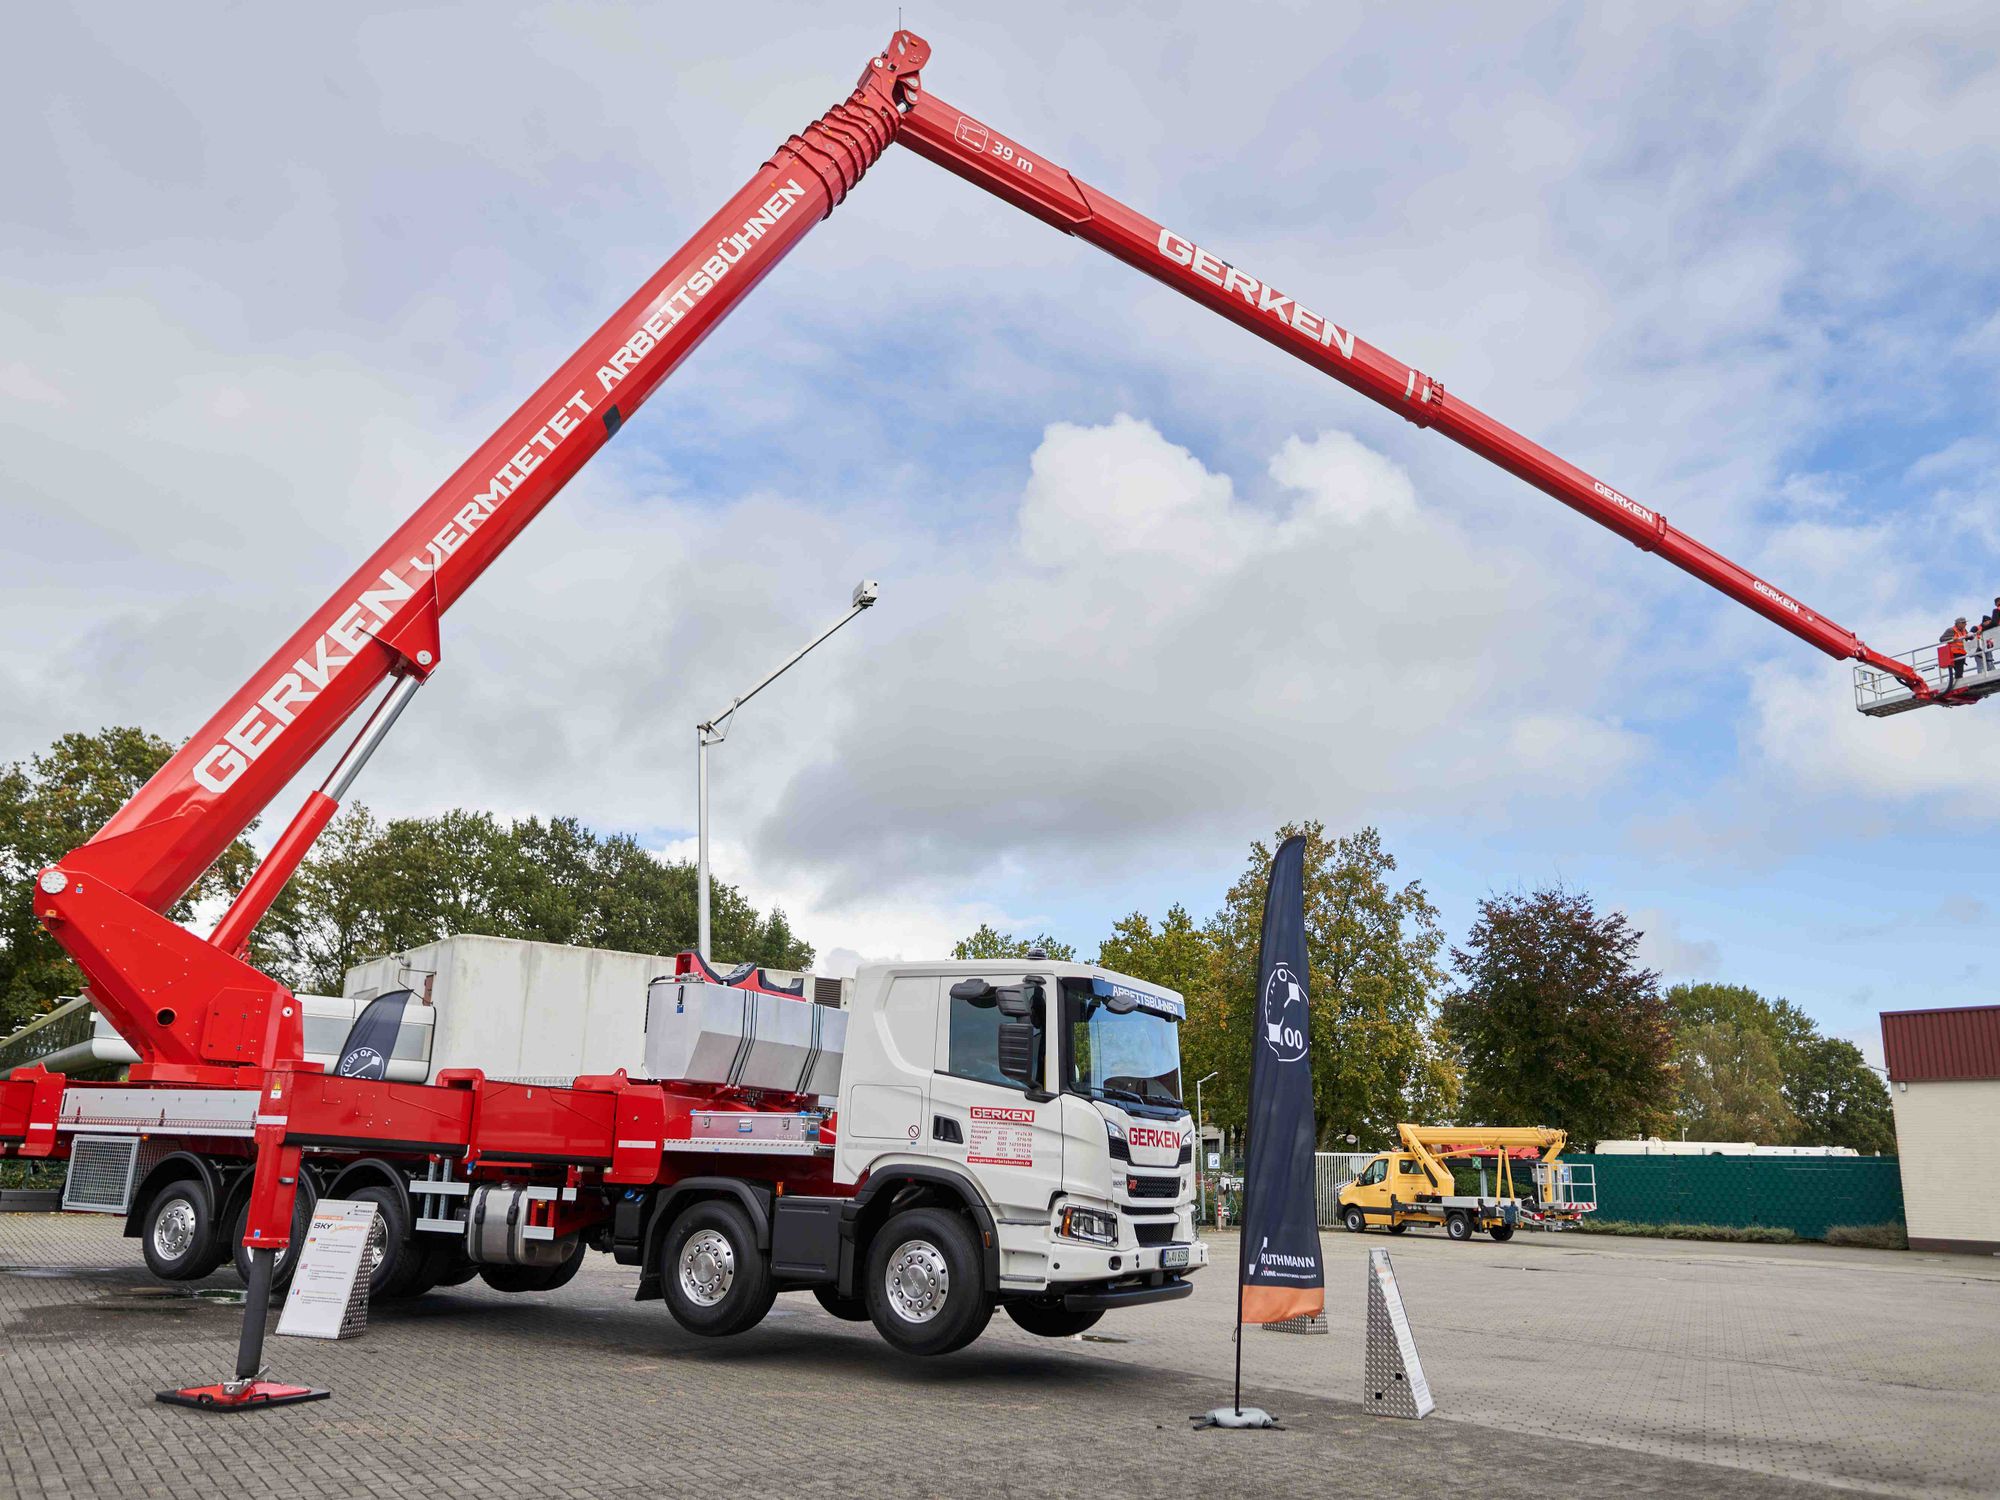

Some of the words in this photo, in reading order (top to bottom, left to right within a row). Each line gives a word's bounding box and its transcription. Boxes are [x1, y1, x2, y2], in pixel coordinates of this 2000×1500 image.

[992, 141, 1013, 160] 39
[1017, 156, 1033, 173] m
[1158, 228, 1354, 359] GERKEN
[193, 568, 415, 793] GERKEN
[409, 389, 593, 571] VERMIETET
[596, 178, 806, 392] ARBEITSBÜHNEN
[1594, 482, 1653, 523] GERKEN
[1754, 581, 1799, 613] GERKEN
[343, 1053, 359, 1073] CLUB
[360, 1050, 372, 1058] OF
[972, 1108, 1033, 1121] GERKEN
[1129, 1127, 1180, 1149] GERKEN
[313, 1222, 334, 1230] SKY
[1261, 1252, 1315, 1268] RUTHMANN
